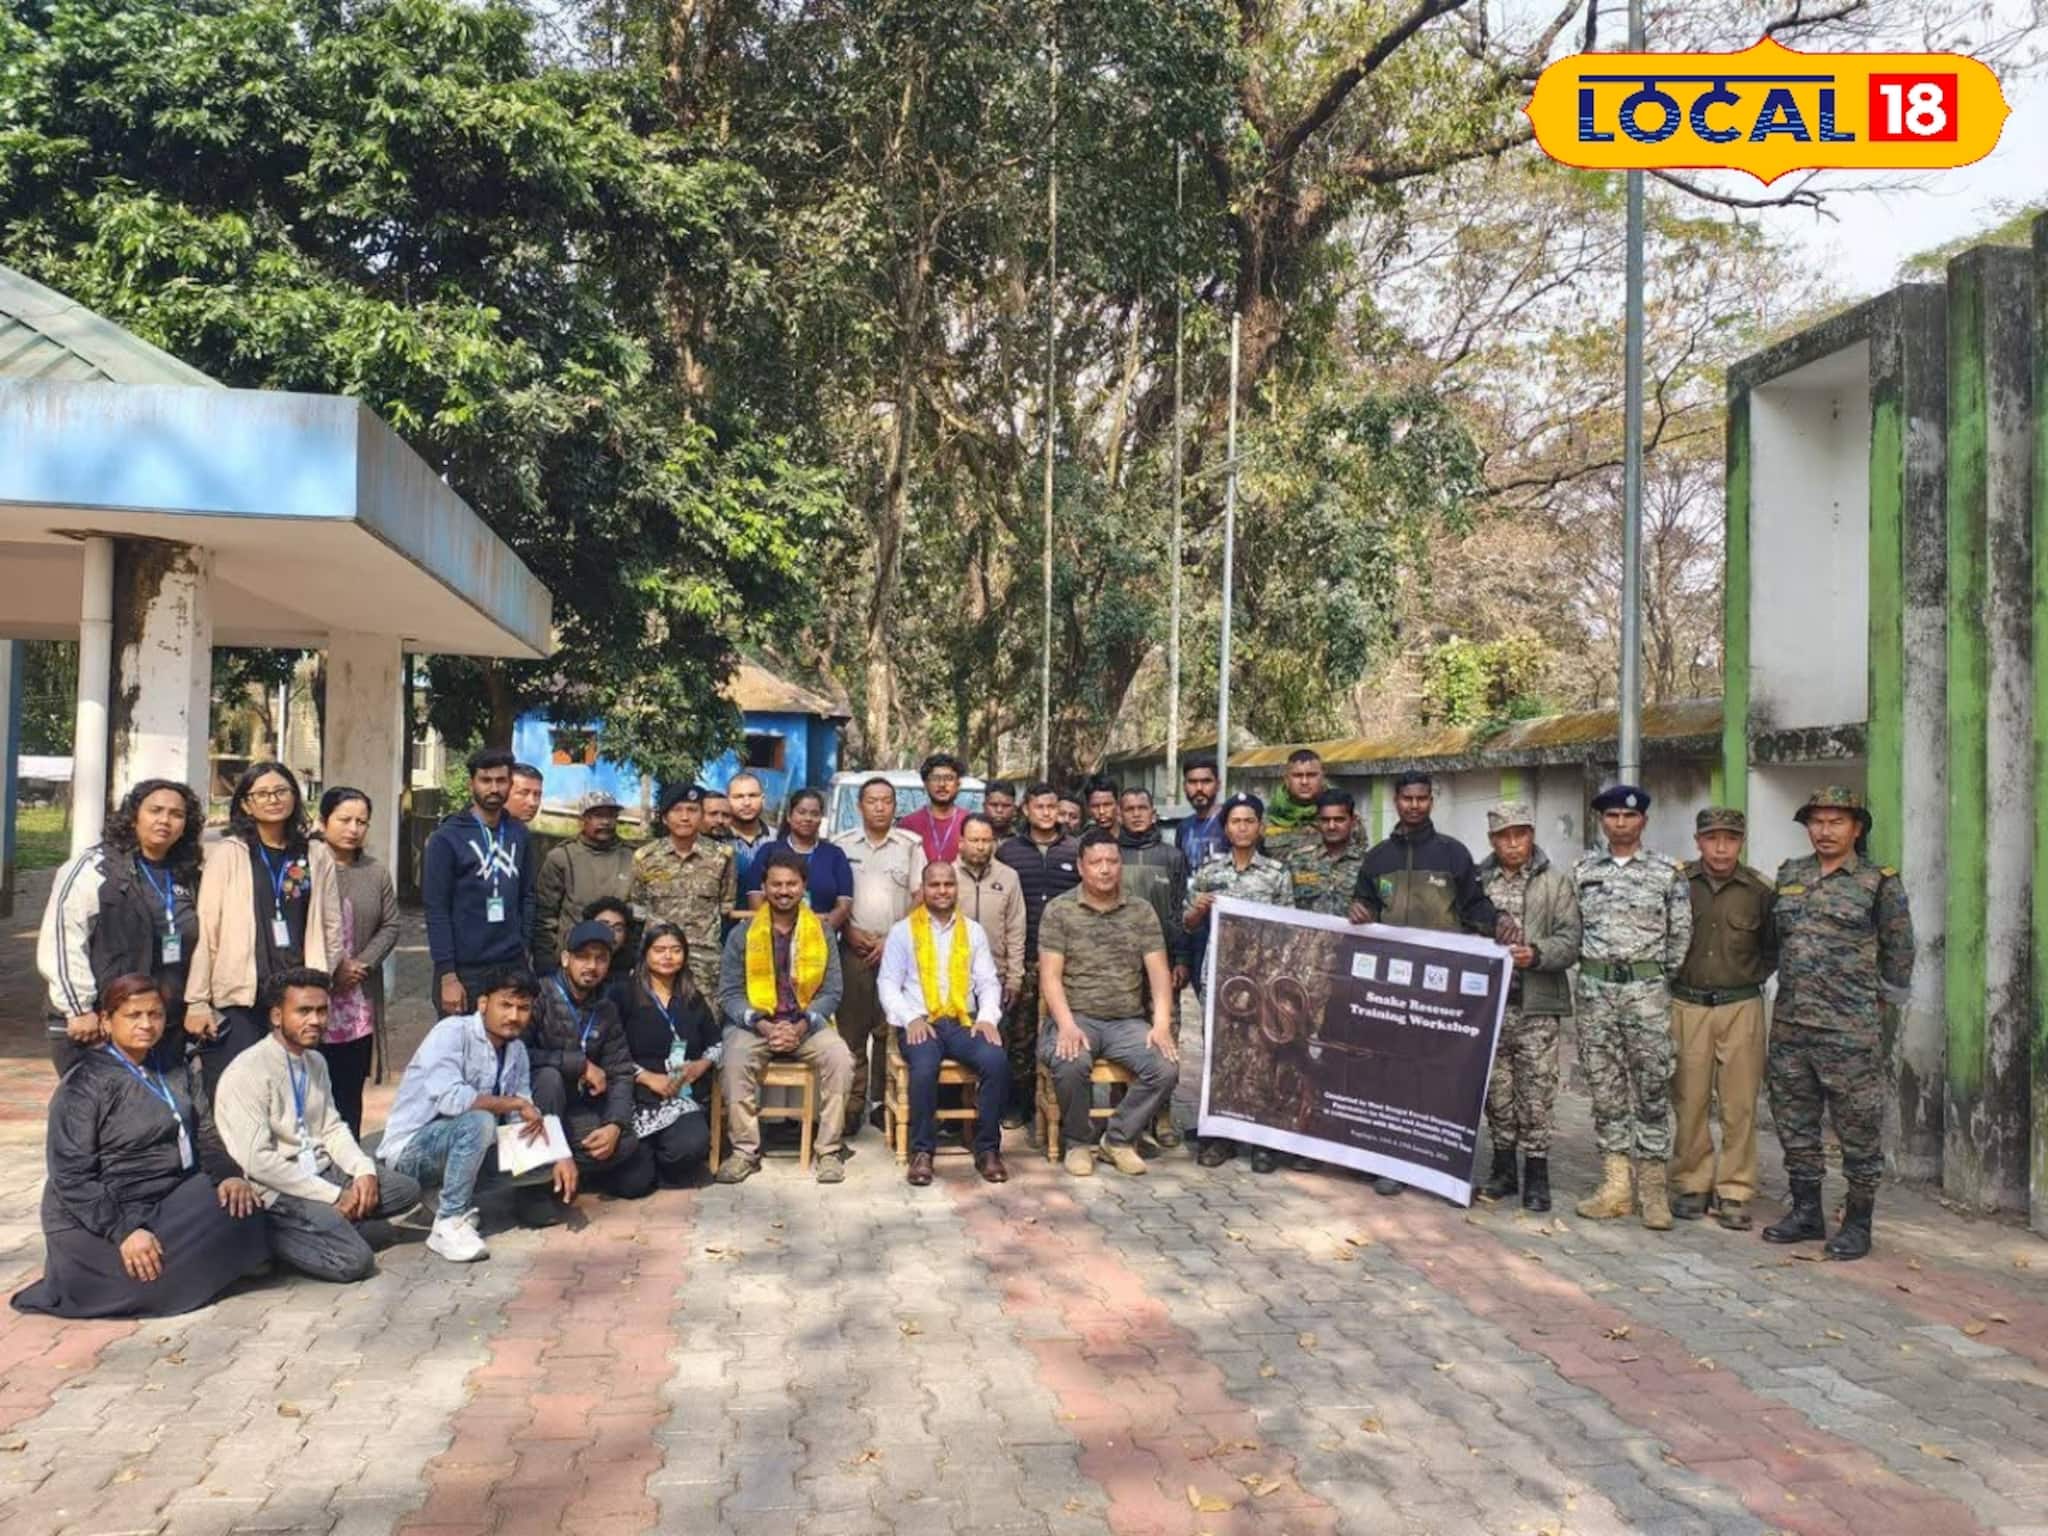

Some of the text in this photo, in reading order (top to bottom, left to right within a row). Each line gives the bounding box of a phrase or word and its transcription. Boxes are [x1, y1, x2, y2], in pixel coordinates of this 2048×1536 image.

[1366, 991, 1464, 1017] Snake Rescuer
[1350, 1003, 1480, 1037] Training Workshop
